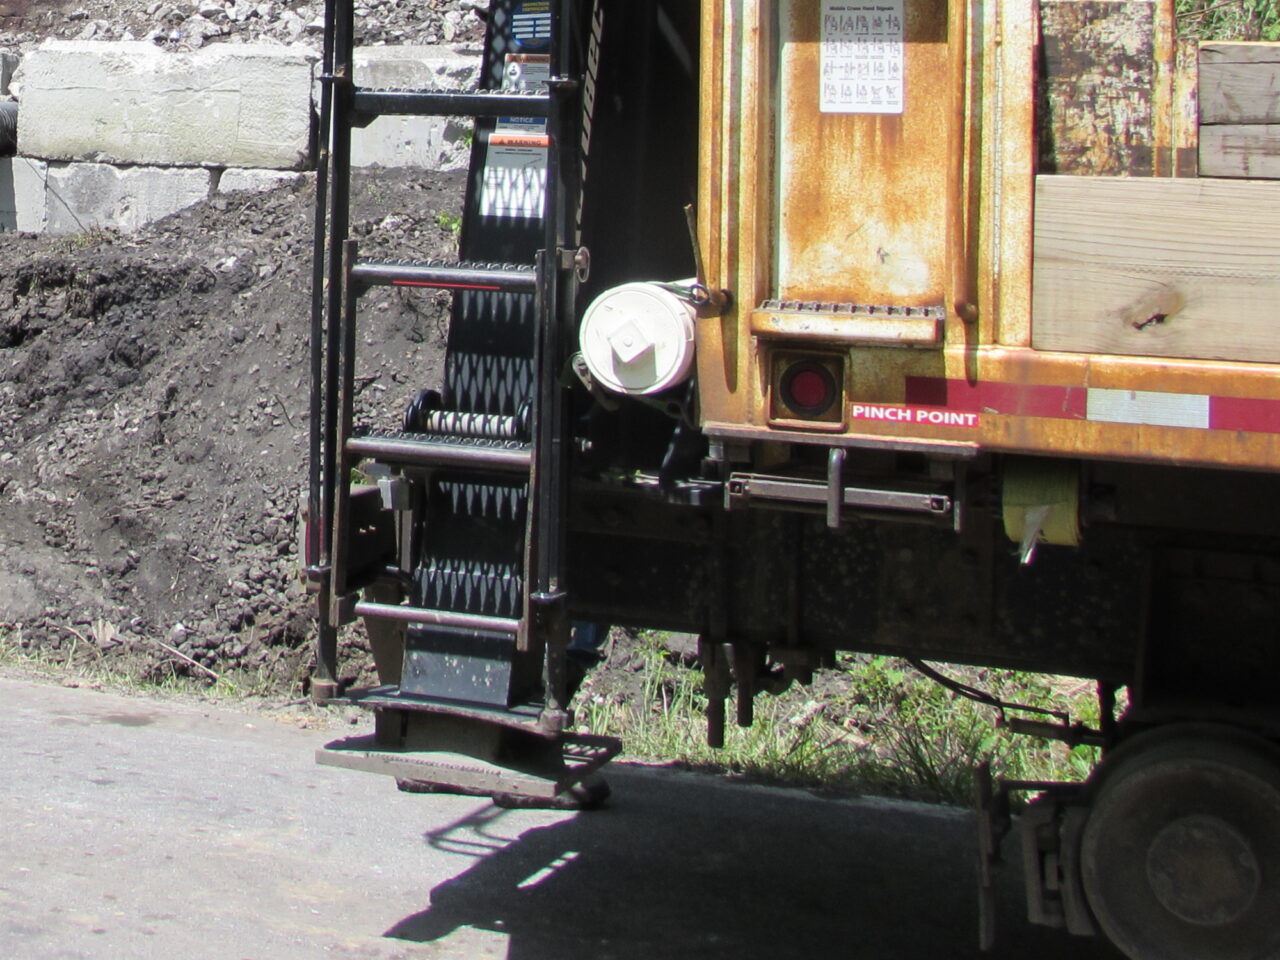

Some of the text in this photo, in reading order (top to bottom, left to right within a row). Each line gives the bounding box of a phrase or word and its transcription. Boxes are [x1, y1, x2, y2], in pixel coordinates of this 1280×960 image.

[507, 138, 542, 146] WARNING
[852, 405, 977, 426] PINCH POINT
